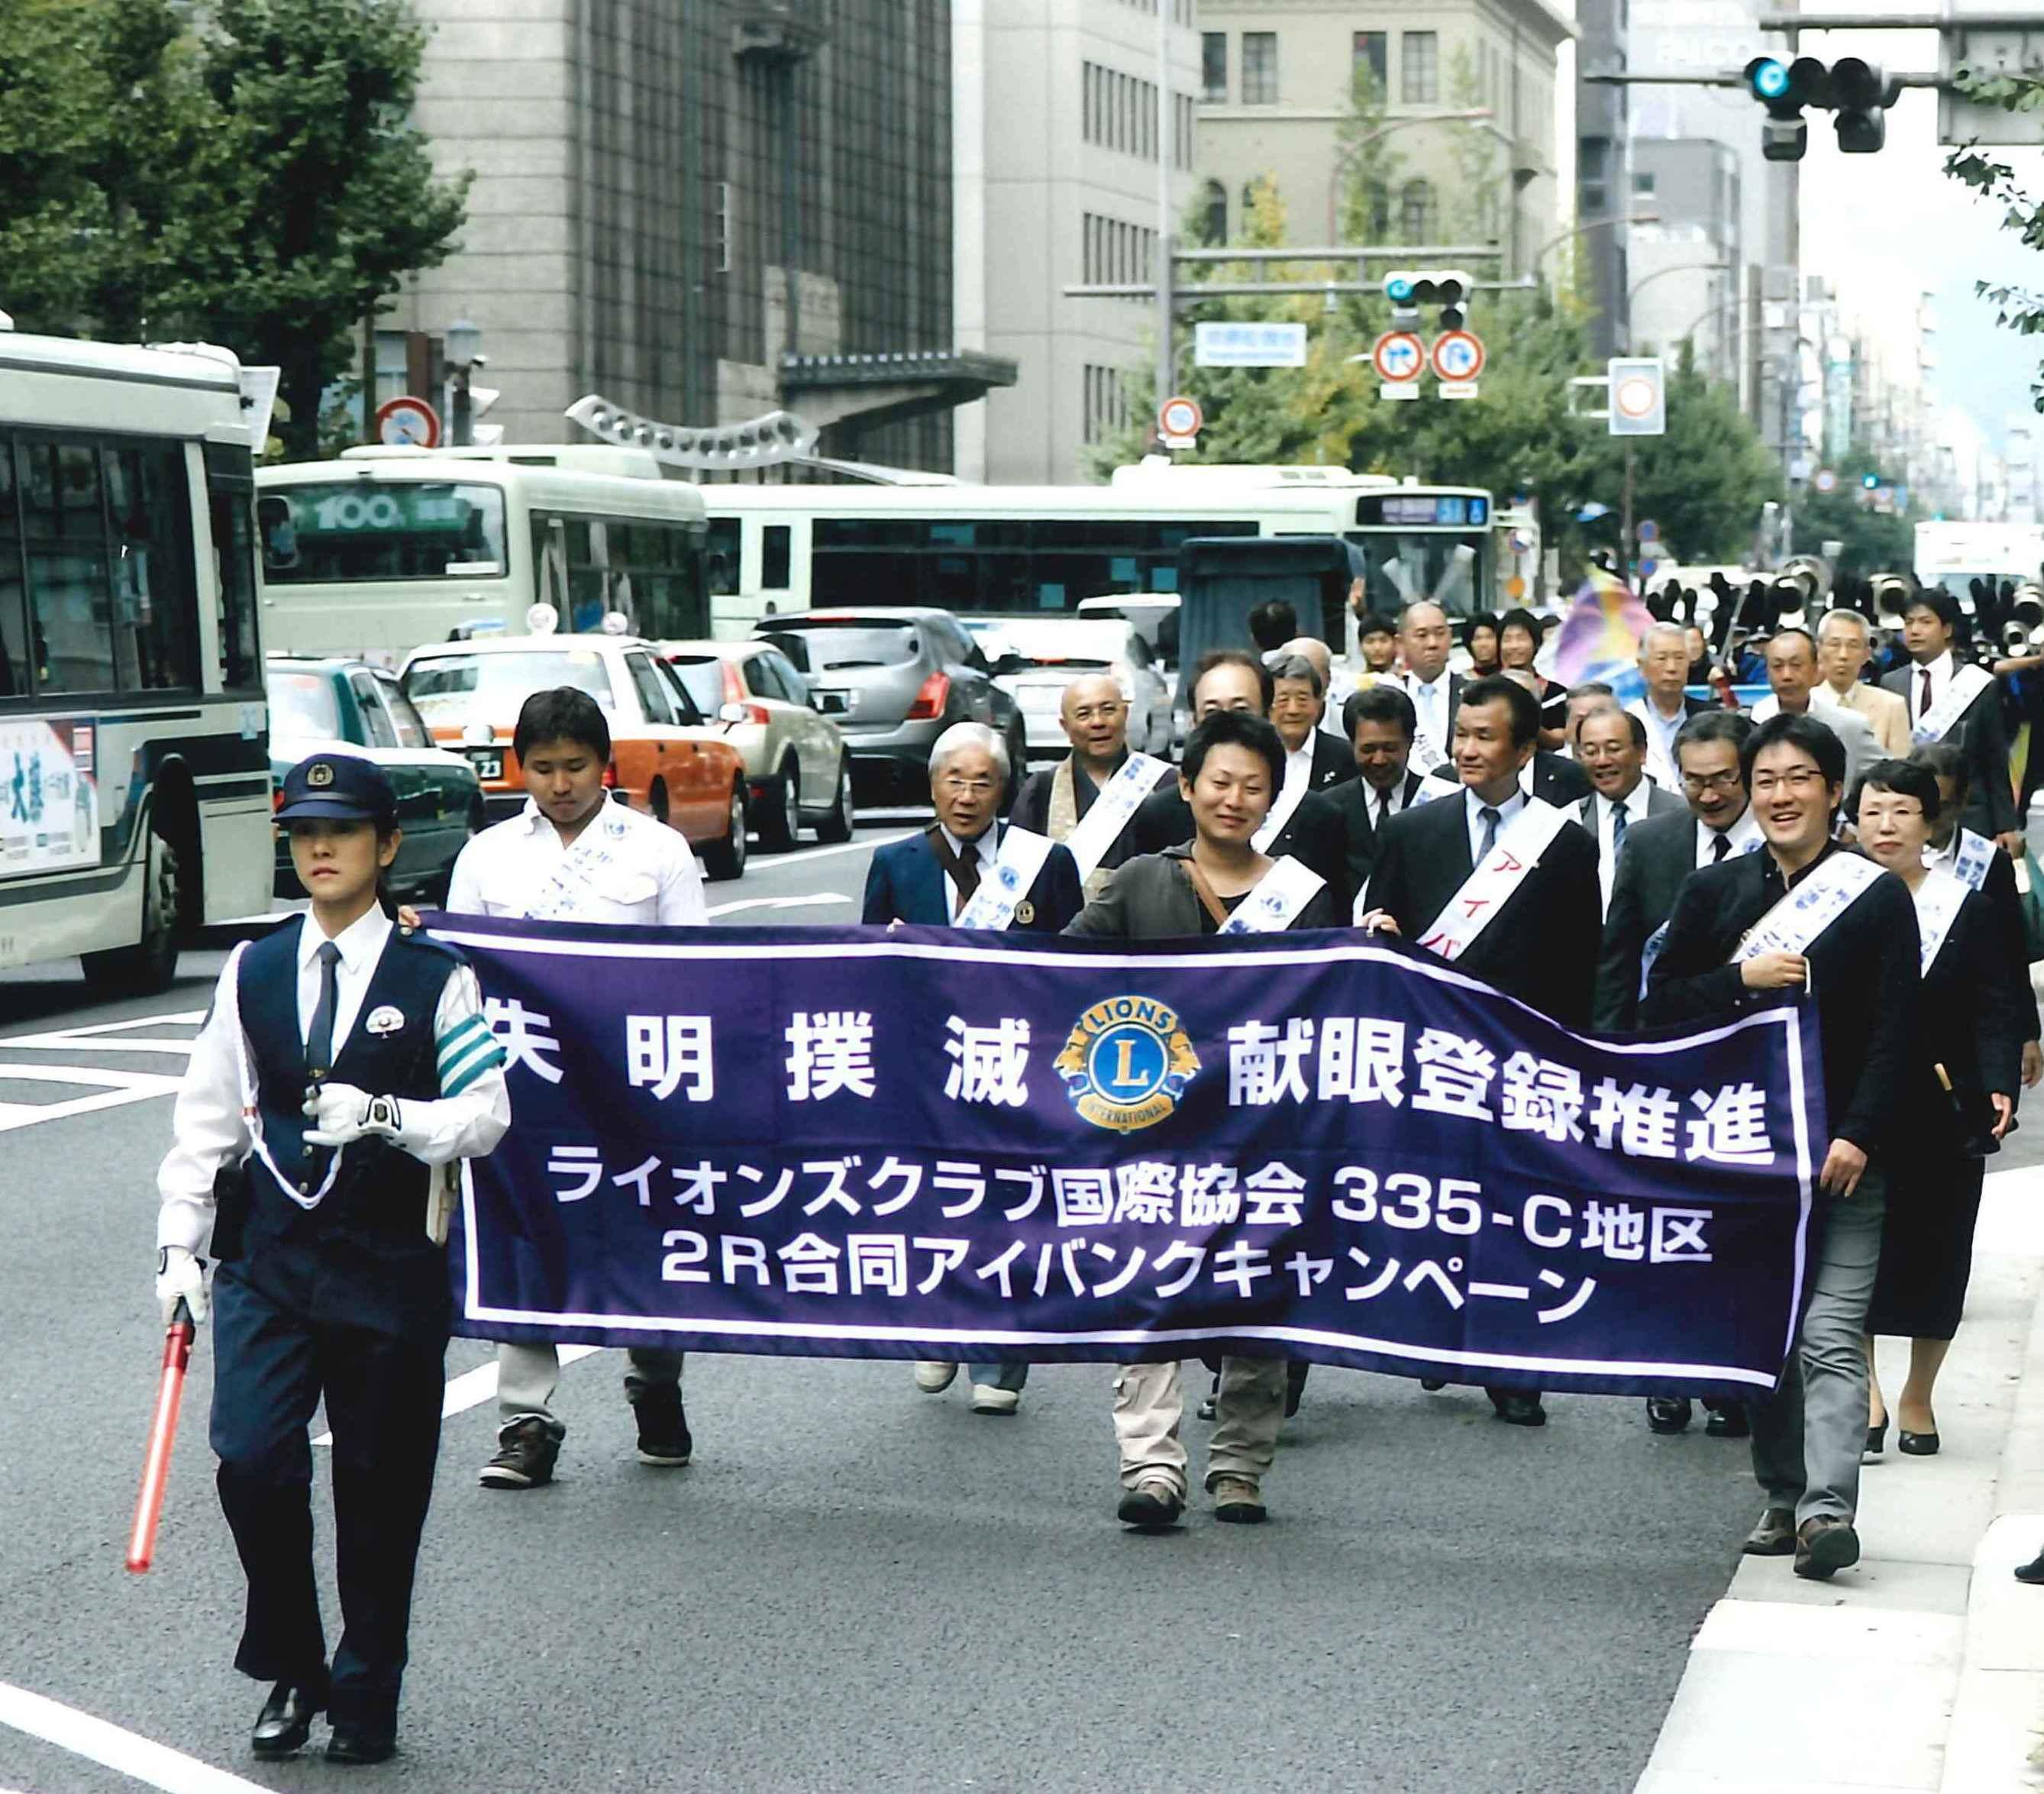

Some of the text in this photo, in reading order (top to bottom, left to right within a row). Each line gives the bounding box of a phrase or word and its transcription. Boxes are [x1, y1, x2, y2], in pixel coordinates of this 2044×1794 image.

[315, 495, 398, 529] 100
[1088, 1000, 1171, 1029] LIONS
[1112, 1039, 1149, 1086] L
[1228, 1017, 1775, 1165] 献眼登録推進
[548, 1147, 1712, 1262] ライオンズクラブ国際協会 335-C地区
[662, 1230, 1596, 1323] 2R合同アイバンクキャンペーン
